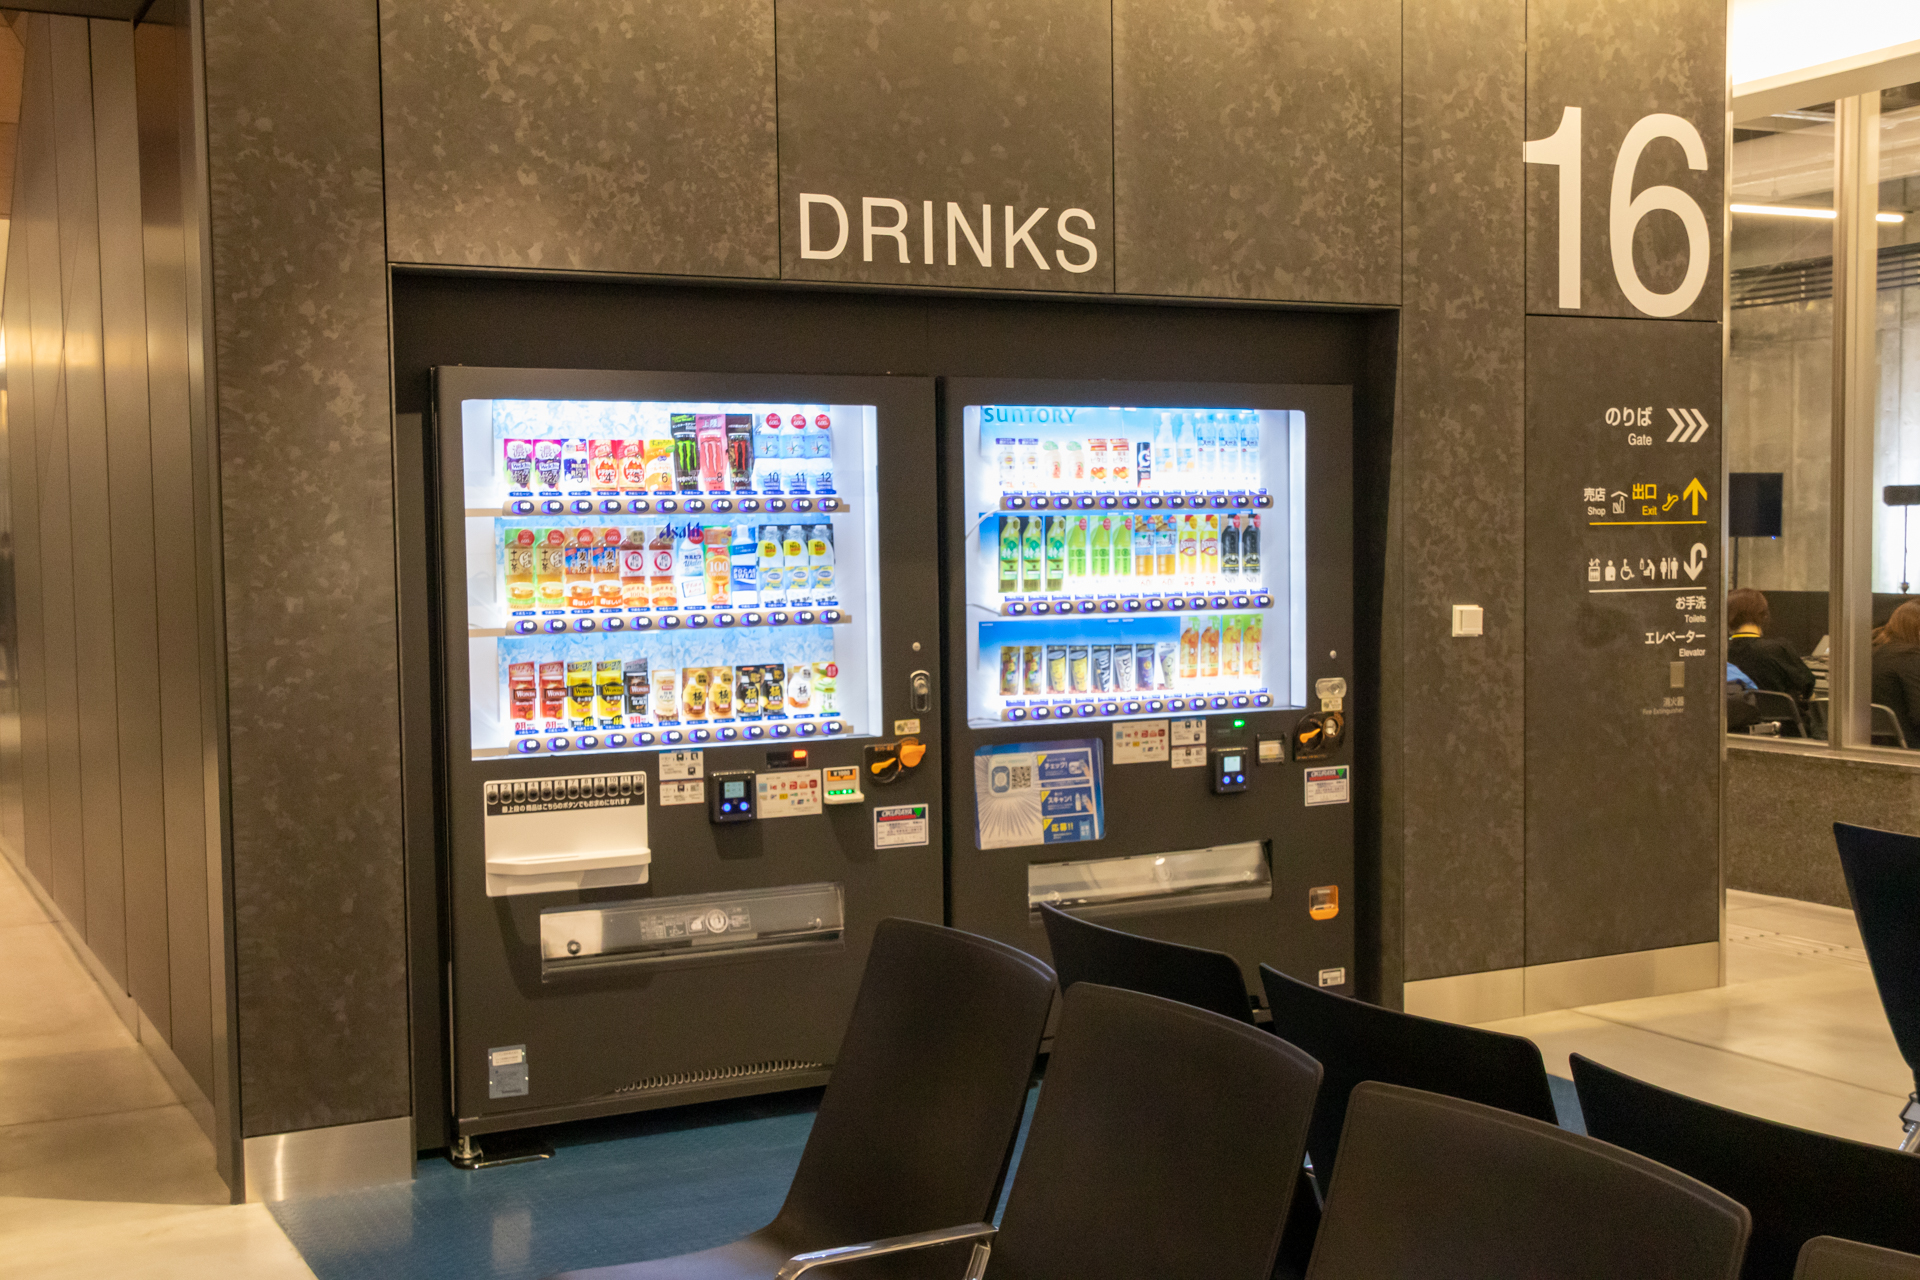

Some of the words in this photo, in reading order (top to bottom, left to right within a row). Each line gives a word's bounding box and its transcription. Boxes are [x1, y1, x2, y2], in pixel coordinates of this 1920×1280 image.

[1523, 106, 1710, 318] 16
[799, 192, 1098, 273] DRINKS
[984, 408, 1076, 423] SUNTORY
[1605, 406, 1653, 427] のりば
[1628, 433, 1652, 446] Gate
[606, 472, 611, 482] 4
[634, 472, 640, 483] 5
[661, 472, 668, 483] 6
[717, 472, 723, 483] 8
[769, 472, 779, 483] 10
[796, 472, 805, 482] 11
[821, 472, 831, 482] 12
[1584, 488, 1606, 502] 売店
[1632, 484, 1657, 500] 出口
[1587, 506, 1606, 518] Shop
[1642, 506, 1658, 516] Exit
[659, 522, 701, 539] Asahi
[578, 551, 588, 573] 麦茶
[605, 550, 615, 572] 麦茶
[709, 561, 728, 572] 100
[1675, 596, 1706, 610] お手洗
[1684, 614, 1706, 624] Toilets
[1644, 631, 1706, 645] エレベーター
[1679, 648, 1706, 658] Elevator
[1663, 696, 1684, 707] 消火器
